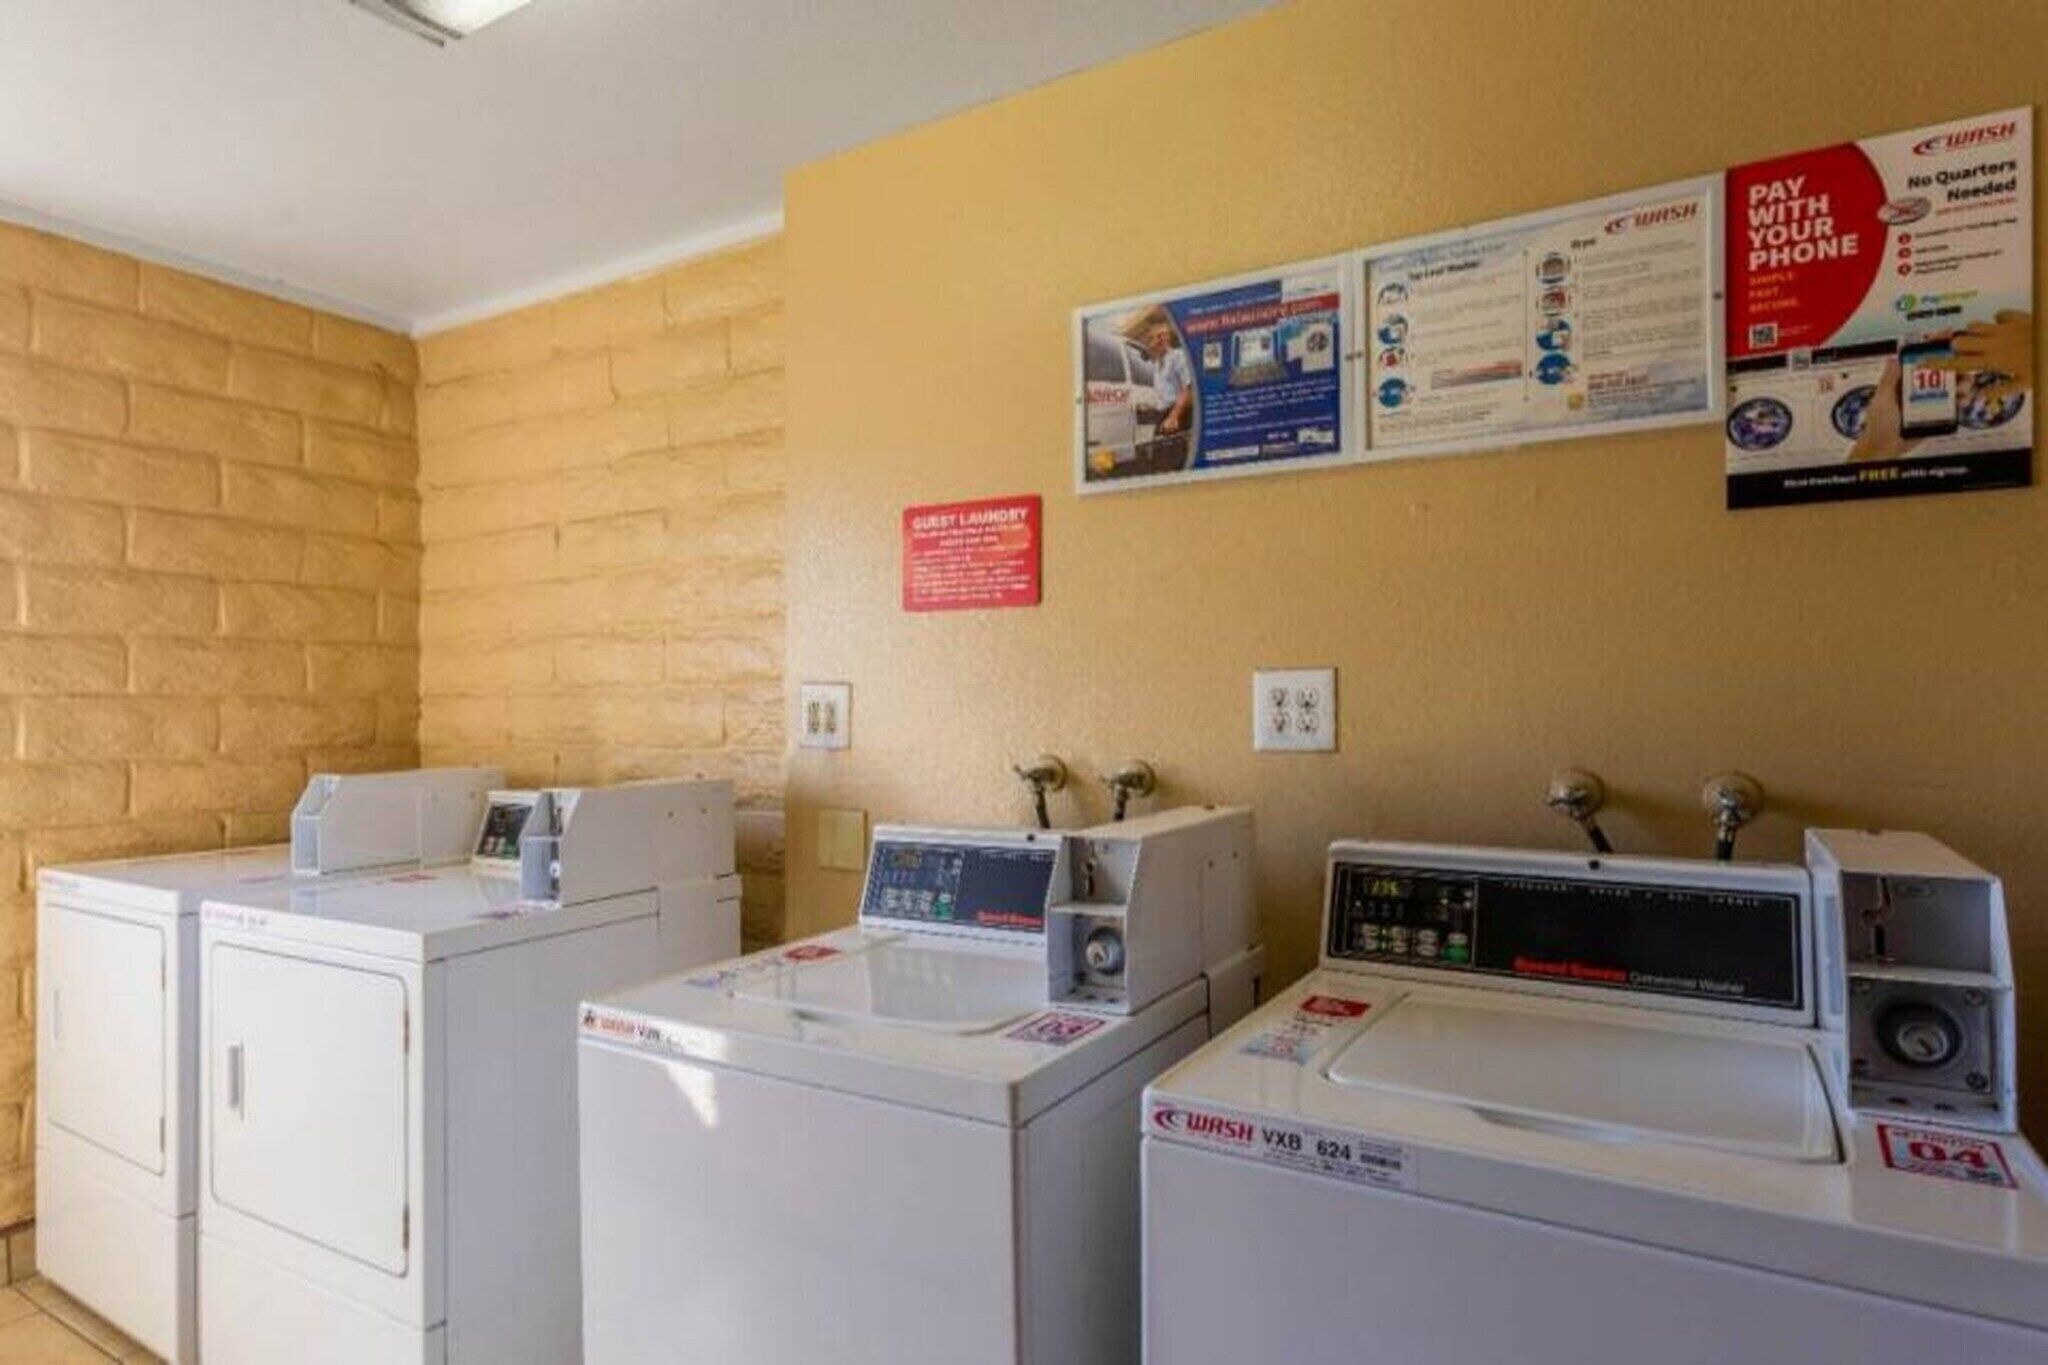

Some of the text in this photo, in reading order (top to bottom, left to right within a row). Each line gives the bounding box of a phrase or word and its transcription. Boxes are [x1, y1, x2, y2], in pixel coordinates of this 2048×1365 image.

[1945, 121, 2016, 148] WASH
[1907, 160, 2017, 190] No Quarters
[1749, 175, 1805, 206] PAY
[1947, 177, 2017, 202] Needed
[1634, 202, 1698, 229] WASH
[1748, 193, 1829, 228] WITH
[1747, 216, 1834, 249] YOUR
[1748, 233, 1859, 272] PHONE
[1914, 371, 1941, 390] 10
[1859, 467, 1899, 482] FREE
[913, 507, 1028, 530] GUEST LAUNDRY
[1187, 1111, 1254, 1142] WASH
[1317, 1139, 1351, 1160] 624
[1908, 1141, 1986, 1169] 04
